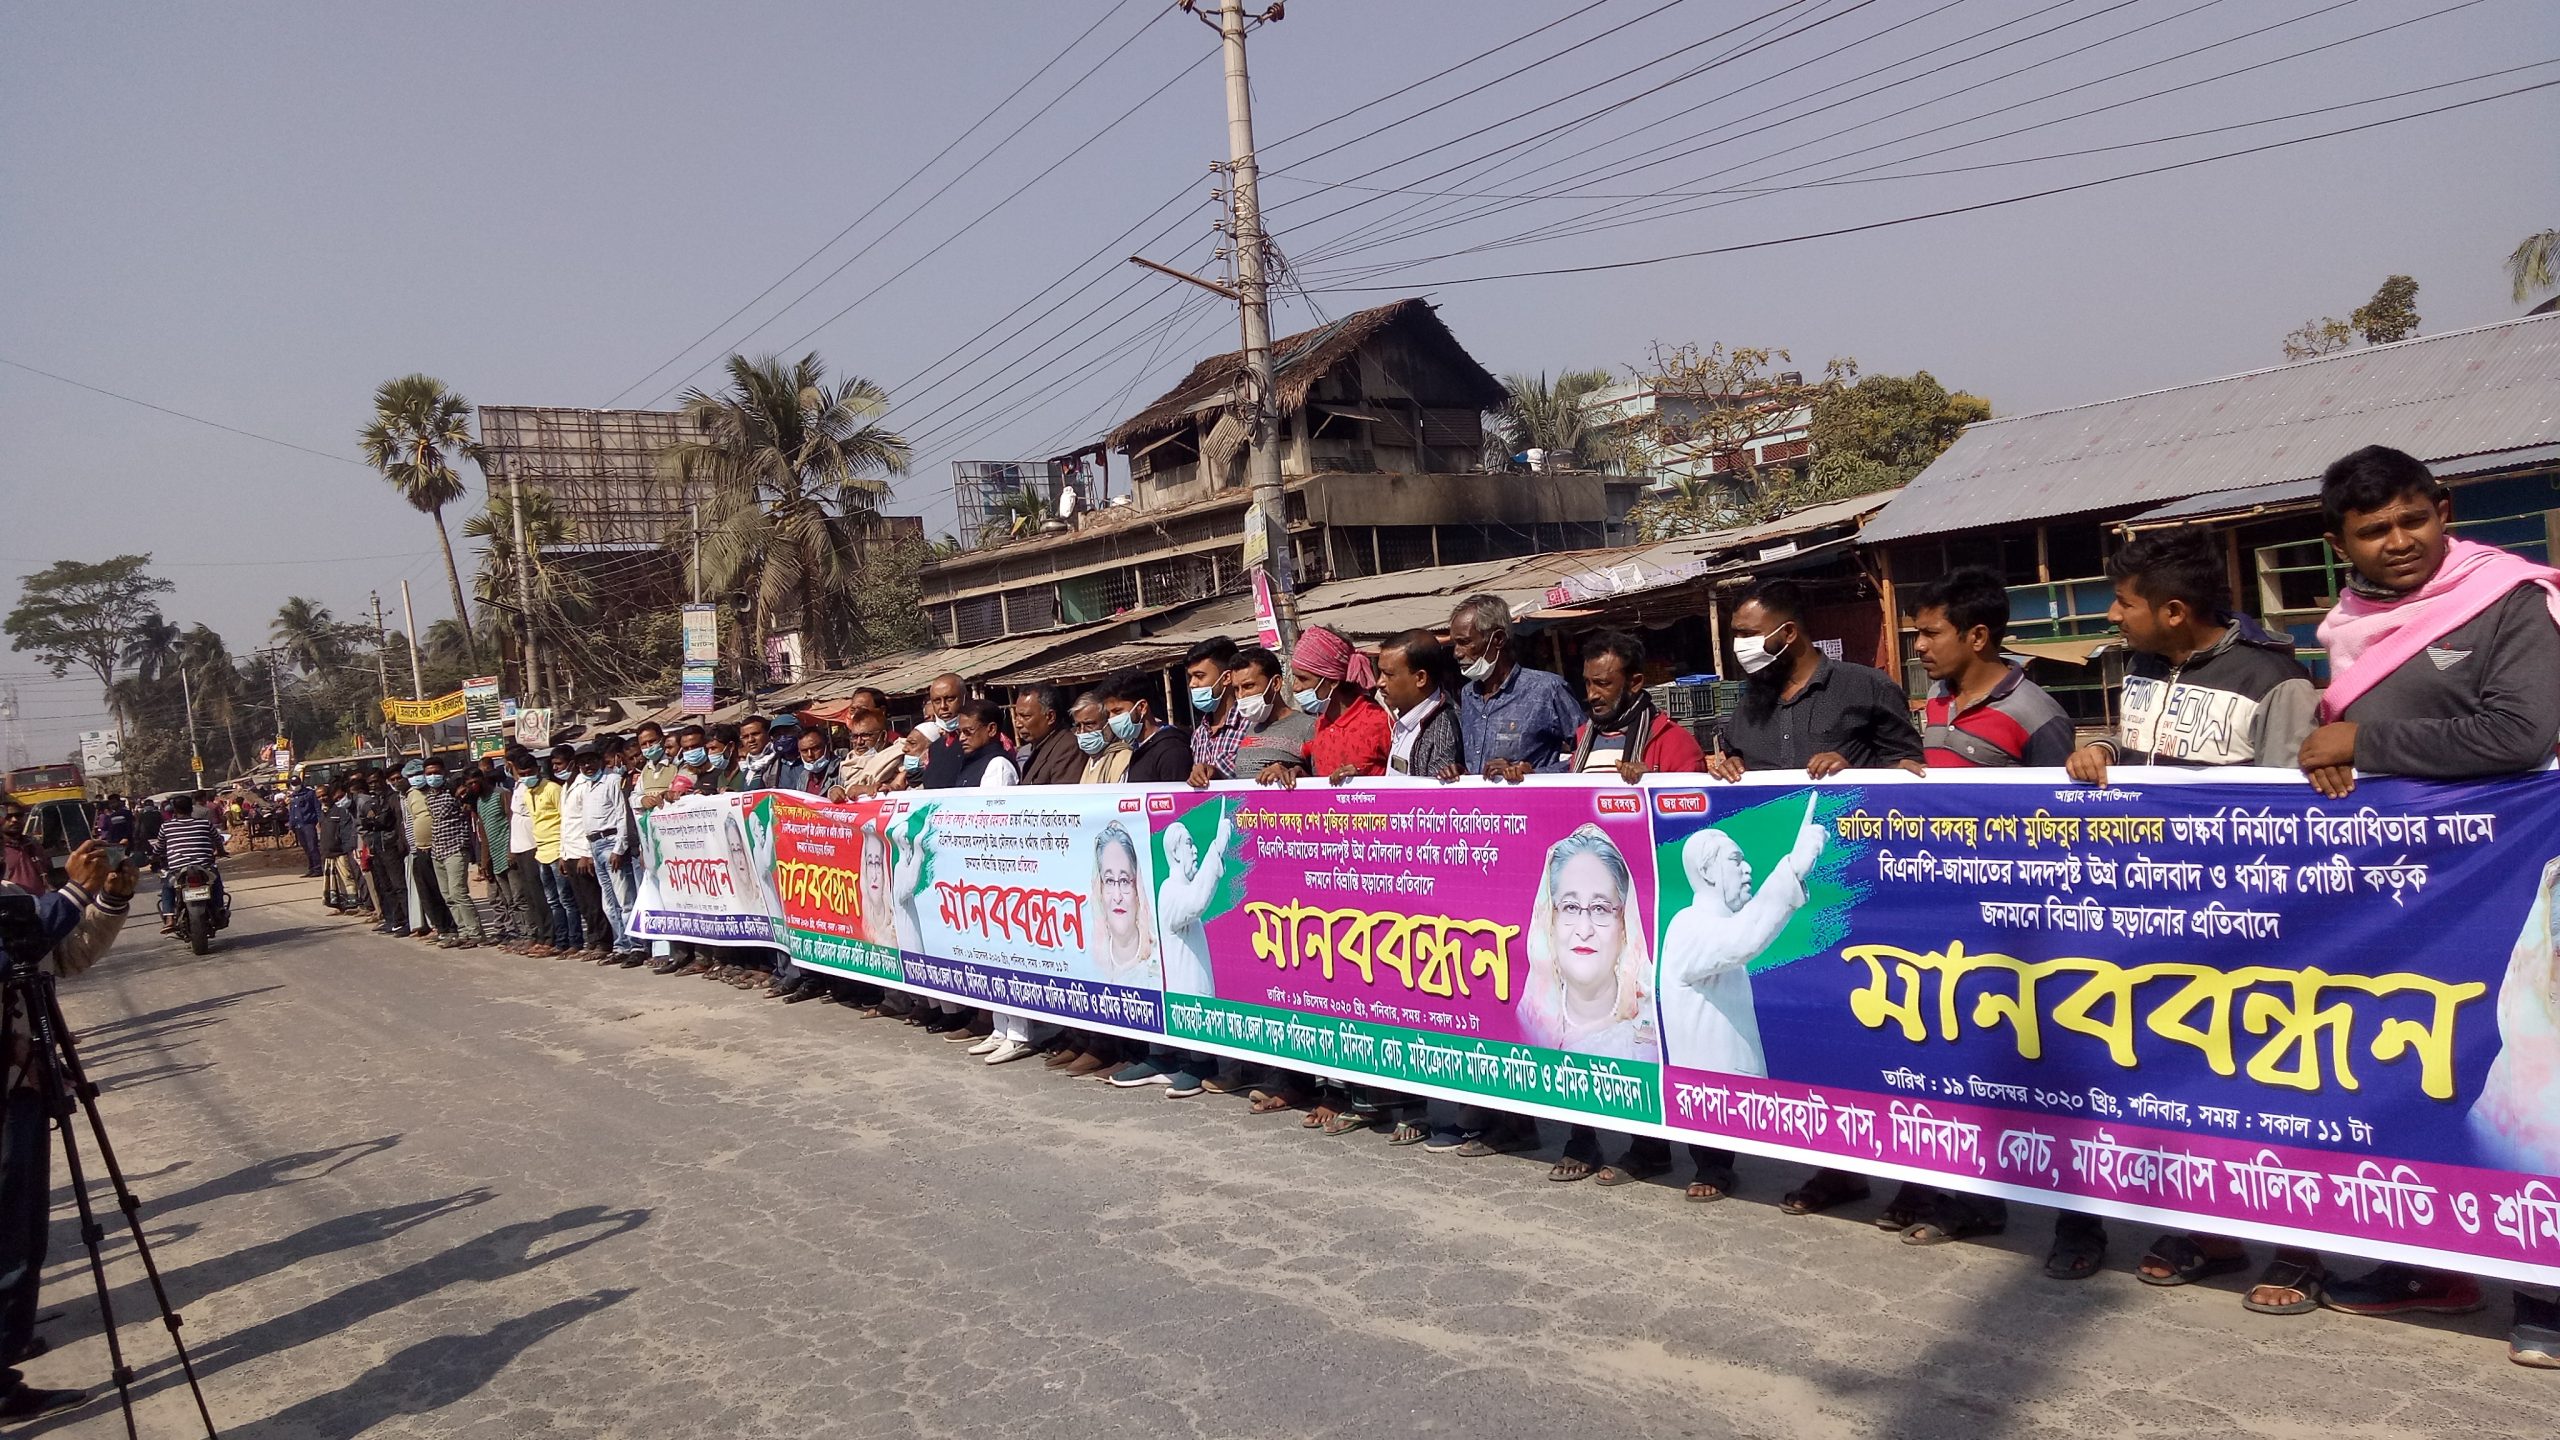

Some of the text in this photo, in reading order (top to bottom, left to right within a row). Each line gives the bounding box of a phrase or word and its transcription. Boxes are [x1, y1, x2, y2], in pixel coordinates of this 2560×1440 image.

[1235, 807, 1258, 829] জাতির
[1259, 808, 1278, 830] পিতা
[1279, 813, 1302, 836] বঙ্গবন্ধু
[1305, 812, 1321, 830] শেখ
[1322, 808, 1350, 835] মুজিবুর
[1351, 812, 1388, 834] রহমানের
[1416, 807, 1447, 833] নির্মাণে
[1449, 808, 1501, 835] বিরোধিতার
[1502, 812, 1527, 835] নামে
[1600, 798, 1637, 813] জয় বঙ্গবন্ধু
[1663, 795, 1701, 810] জয় বাংলা
[1836, 809, 1882, 841] জাতির
[1888, 809, 1924, 841] পিতা
[1930, 815, 1979, 849] বঙ্গবন্ধু
[1985, 814, 2018, 842] শেখ
[2022, 808, 2081, 850] মুজিবুর
[2085, 814, 2165, 847] রহমানের
[2230, 806, 2300, 846] নির্মাণে
[2304, 806, 2429, 847] বিরোধিতার
[2433, 811, 2496, 844] নামে
[665, 856, 735, 897] মানববন্ধন
[1257, 836, 1499, 876] বিএনপি-জামাতের মদদপুষ্ট উগ্র মৌলবাদ ও ধর্মান্ধ গোষ্ঠী কর্তৃক
[1879, 849, 2428, 907] বিএনপি-জামাতের মদদপুষ্ট উগ্র মৌলবাদ ও ধর্মান্ধ গোষ্ঠী কর্তৃক
[1304, 867, 1435, 896] জনমনে বিভ্রান্তি ছড়ানোর প্রতিবাদে
[934, 878, 1087, 950] মানববন্ধন
[1979, 895, 2281, 940] জনমনে বিভ্রান্তি ছড়ানোর প্রতিবাদে
[1244, 897, 1521, 1001] মানববন্ধন
[1266, 986, 1286, 1003] তারিখ
[1303, 991, 1329, 1010] ডিসেম্বর
[1330, 999, 1352, 1015] ২০২০
[1369, 1001, 1400, 1023] শনিবার,
[1401, 1009, 1421, 1024] সময়
[1429, 1010, 1453, 1028] সকাল
[1455, 1014, 1468, 1031] ১১
[1469, 1012, 1481, 1032] টা
[1840, 939, 2486, 1099] মানববন্ধন
[1170, 998, 1226, 1042] বাগেরহাট-রূপসা
[1265, 1019, 1285, 1053] সড়ক
[1286, 1014, 1319, 1058] পরিবহন
[1319, 1026, 1339, 1066] বাস,
[1339, 1022, 1379, 1072] মিনিবাস,
[1381, 1035, 1407, 1078] কোচ,
[1407, 1033, 1464, 1080] মাইক্রোবাস
[1465, 1042, 1500, 1087] মালিক
[1501, 1047, 1538, 1092] সমিতি
[1540, 1066, 1552, 1093] ও
[1554, 1055, 1589, 1102] শ্রমিক
[1881, 1067, 1927, 1092] তারিখ
[1942, 1078, 1964, 1096] ১৯
[1967, 1075, 2028, 1104] ডিসেম্বর
[2034, 1088, 2084, 1111] ২০২০
[2128, 1093, 2192, 1128] শনিবার,
[2198, 1105, 2240, 1130] সময়
[2258, 1112, 2312, 1139] সকাল
[2317, 1119, 2343, 1142] ১১
[2348, 1116, 2374, 1146] টা
[1674, 1081, 1829, 1145] রূপসা-বাগেরহাট
[1832, 1101, 1883, 1159] বাস,
[1888, 1100, 1987, 1176] মিনিবাস,
[1998, 1126, 2059, 1188] কোচ,
[2070, 1127, 2218, 1205] মাইক্রোবাস
[2222, 1149, 2324, 1217] মালিক
[2328, 1160, 2439, 1230] সমিতি
[2449, 1192, 2480, 1235] ও
